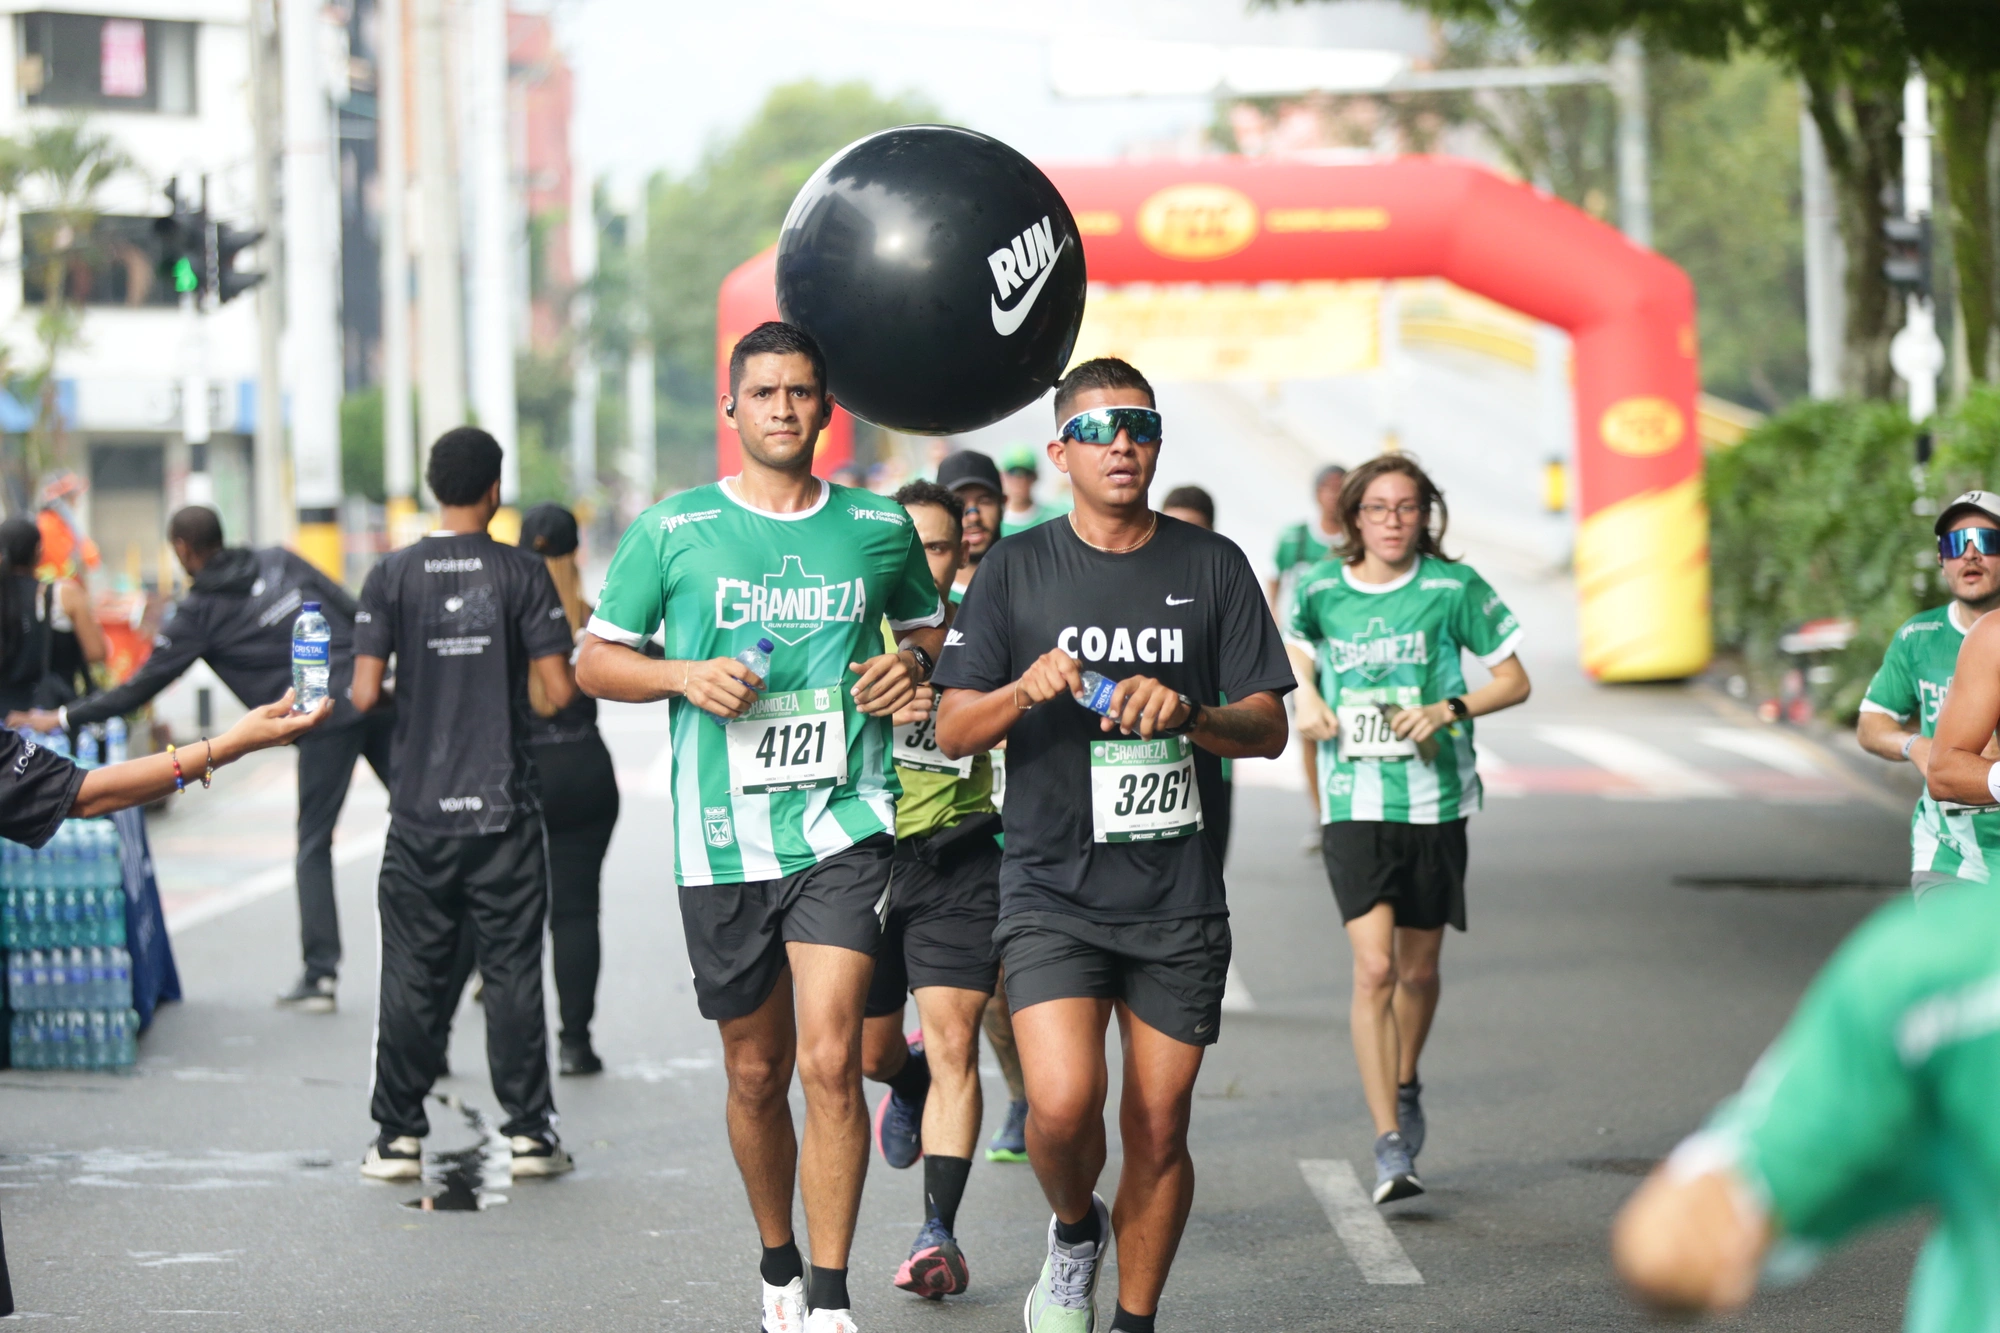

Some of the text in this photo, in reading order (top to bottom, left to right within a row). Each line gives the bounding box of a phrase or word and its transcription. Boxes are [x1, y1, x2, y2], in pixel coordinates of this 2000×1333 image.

[987, 215, 1055, 301] RUN
[665, 513, 689, 534] JFK
[854, 509, 876, 520] JFK
[715, 577, 867, 630] GRANDEZA
[294, 645, 324, 654] CRISTAL
[1057, 626, 1184, 663] COACH
[1095, 683, 1113, 709] CRISTAL
[755, 721, 827, 768] 4121
[1104, 740, 1169, 764] GRANDEZA
[1114, 764, 1192, 817] 3267
